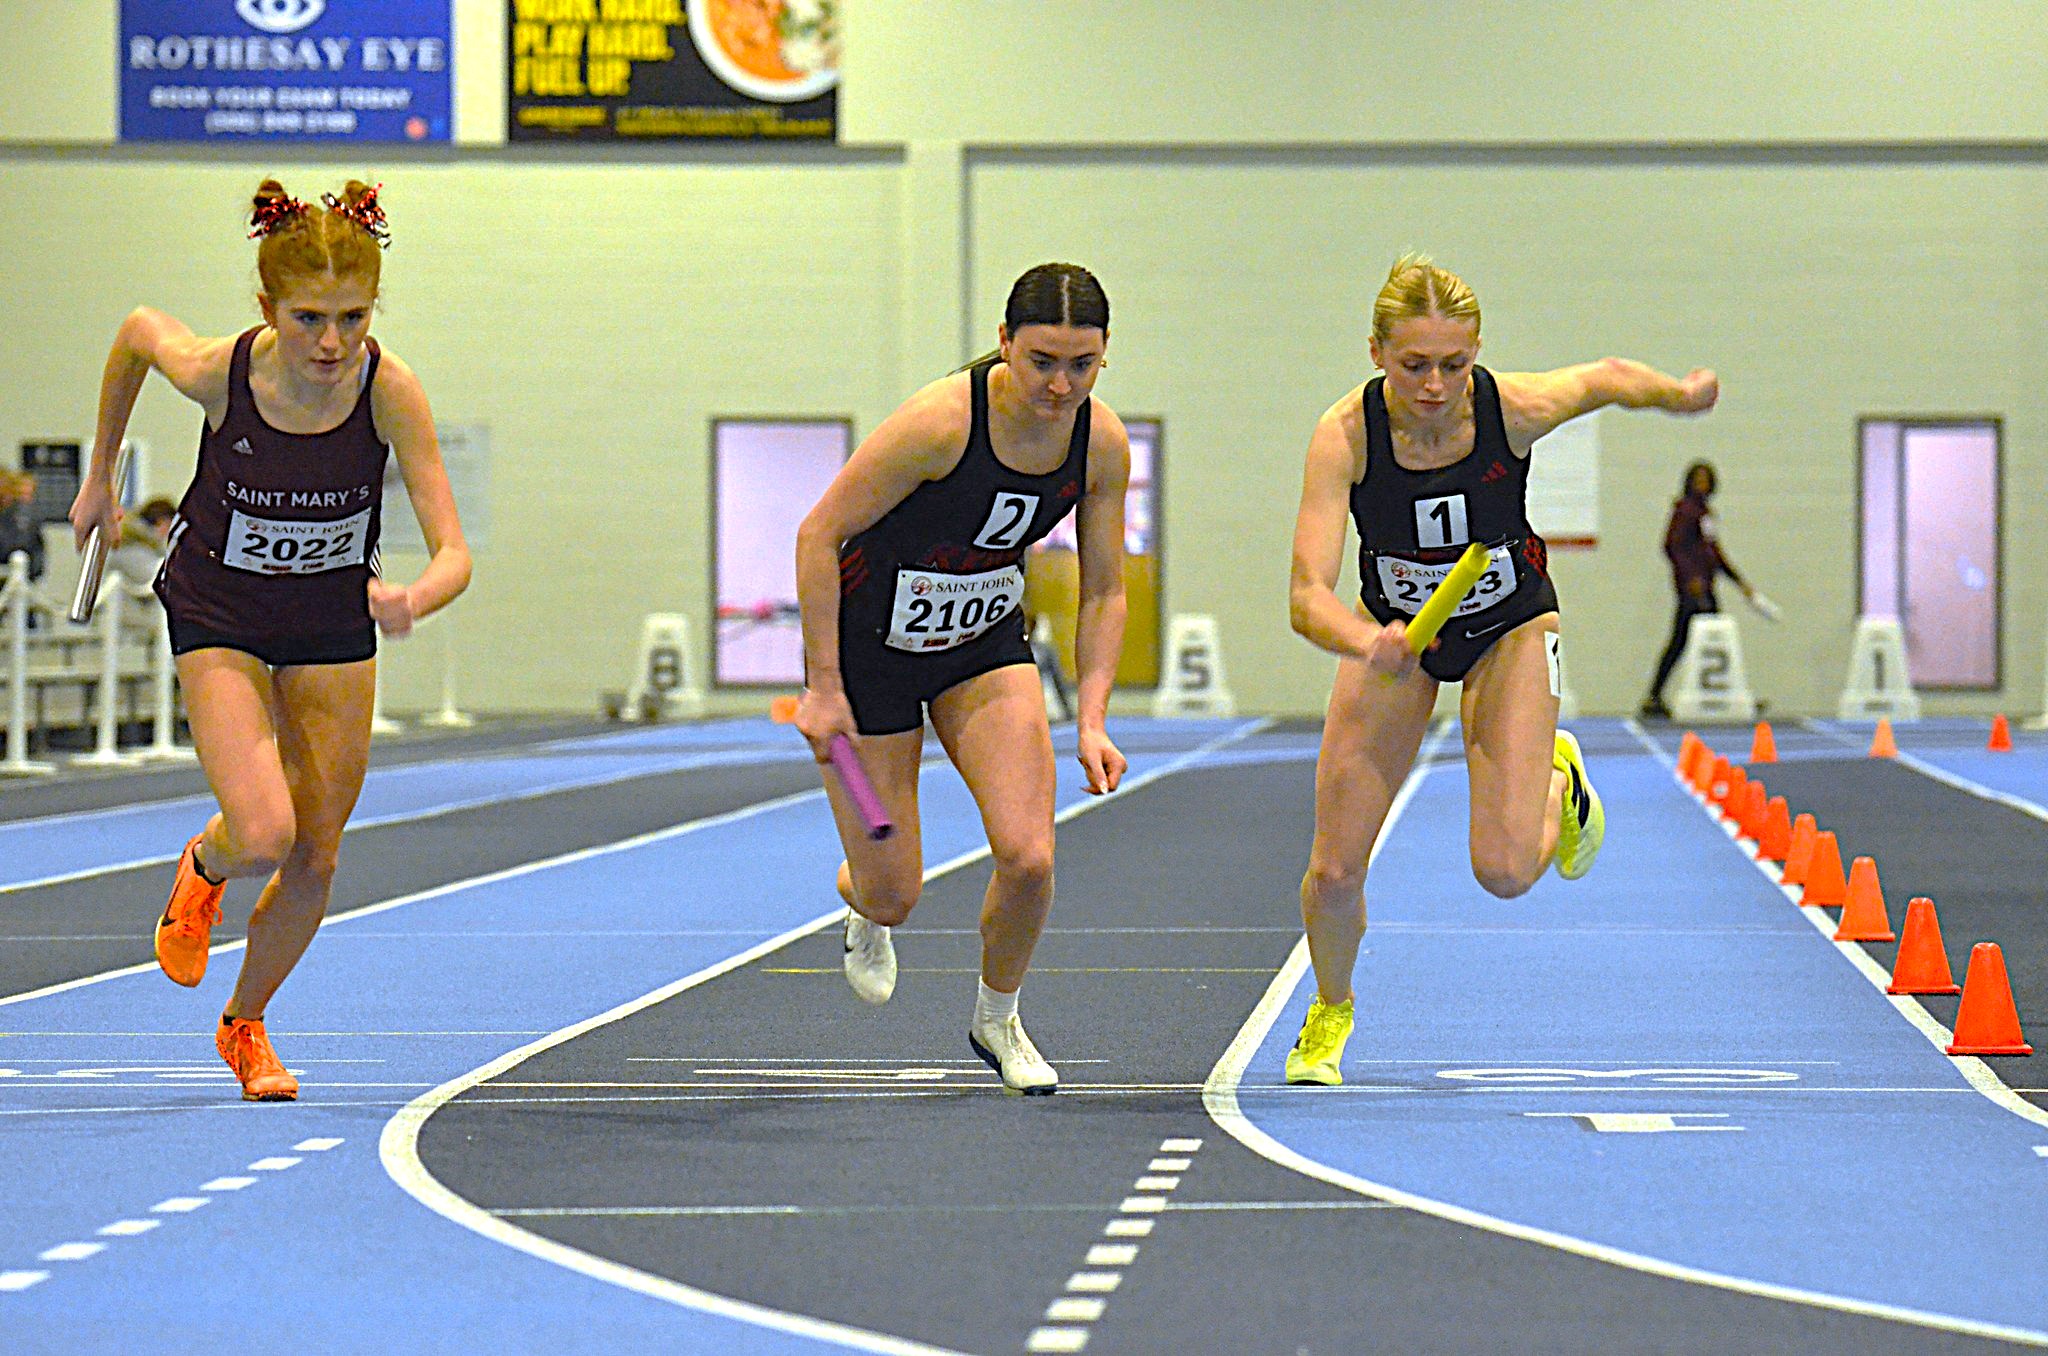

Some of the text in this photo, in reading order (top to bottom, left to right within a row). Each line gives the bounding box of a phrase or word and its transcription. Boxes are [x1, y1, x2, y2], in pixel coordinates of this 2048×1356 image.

[129, 35, 445, 71] ROTHESAY EYE
[513, 23, 584, 57] PLAY
[227, 480, 285, 507] SAINT
[271, 519, 360, 535] SAINT JOHN
[984, 497, 1026, 545] 2
[1429, 499, 1453, 545] 1
[242, 532, 354, 561] 2022
[935, 574, 1015, 593] SAINT JOHN
[1395, 570, 1502, 603] 23
[1414, 568, 1452, 578] SAIN
[905, 594, 1009, 633] 2106
[1180, 646, 1210, 690] 5
[1701, 648, 1730, 690] 2
[1874, 648, 1886, 690] 1
